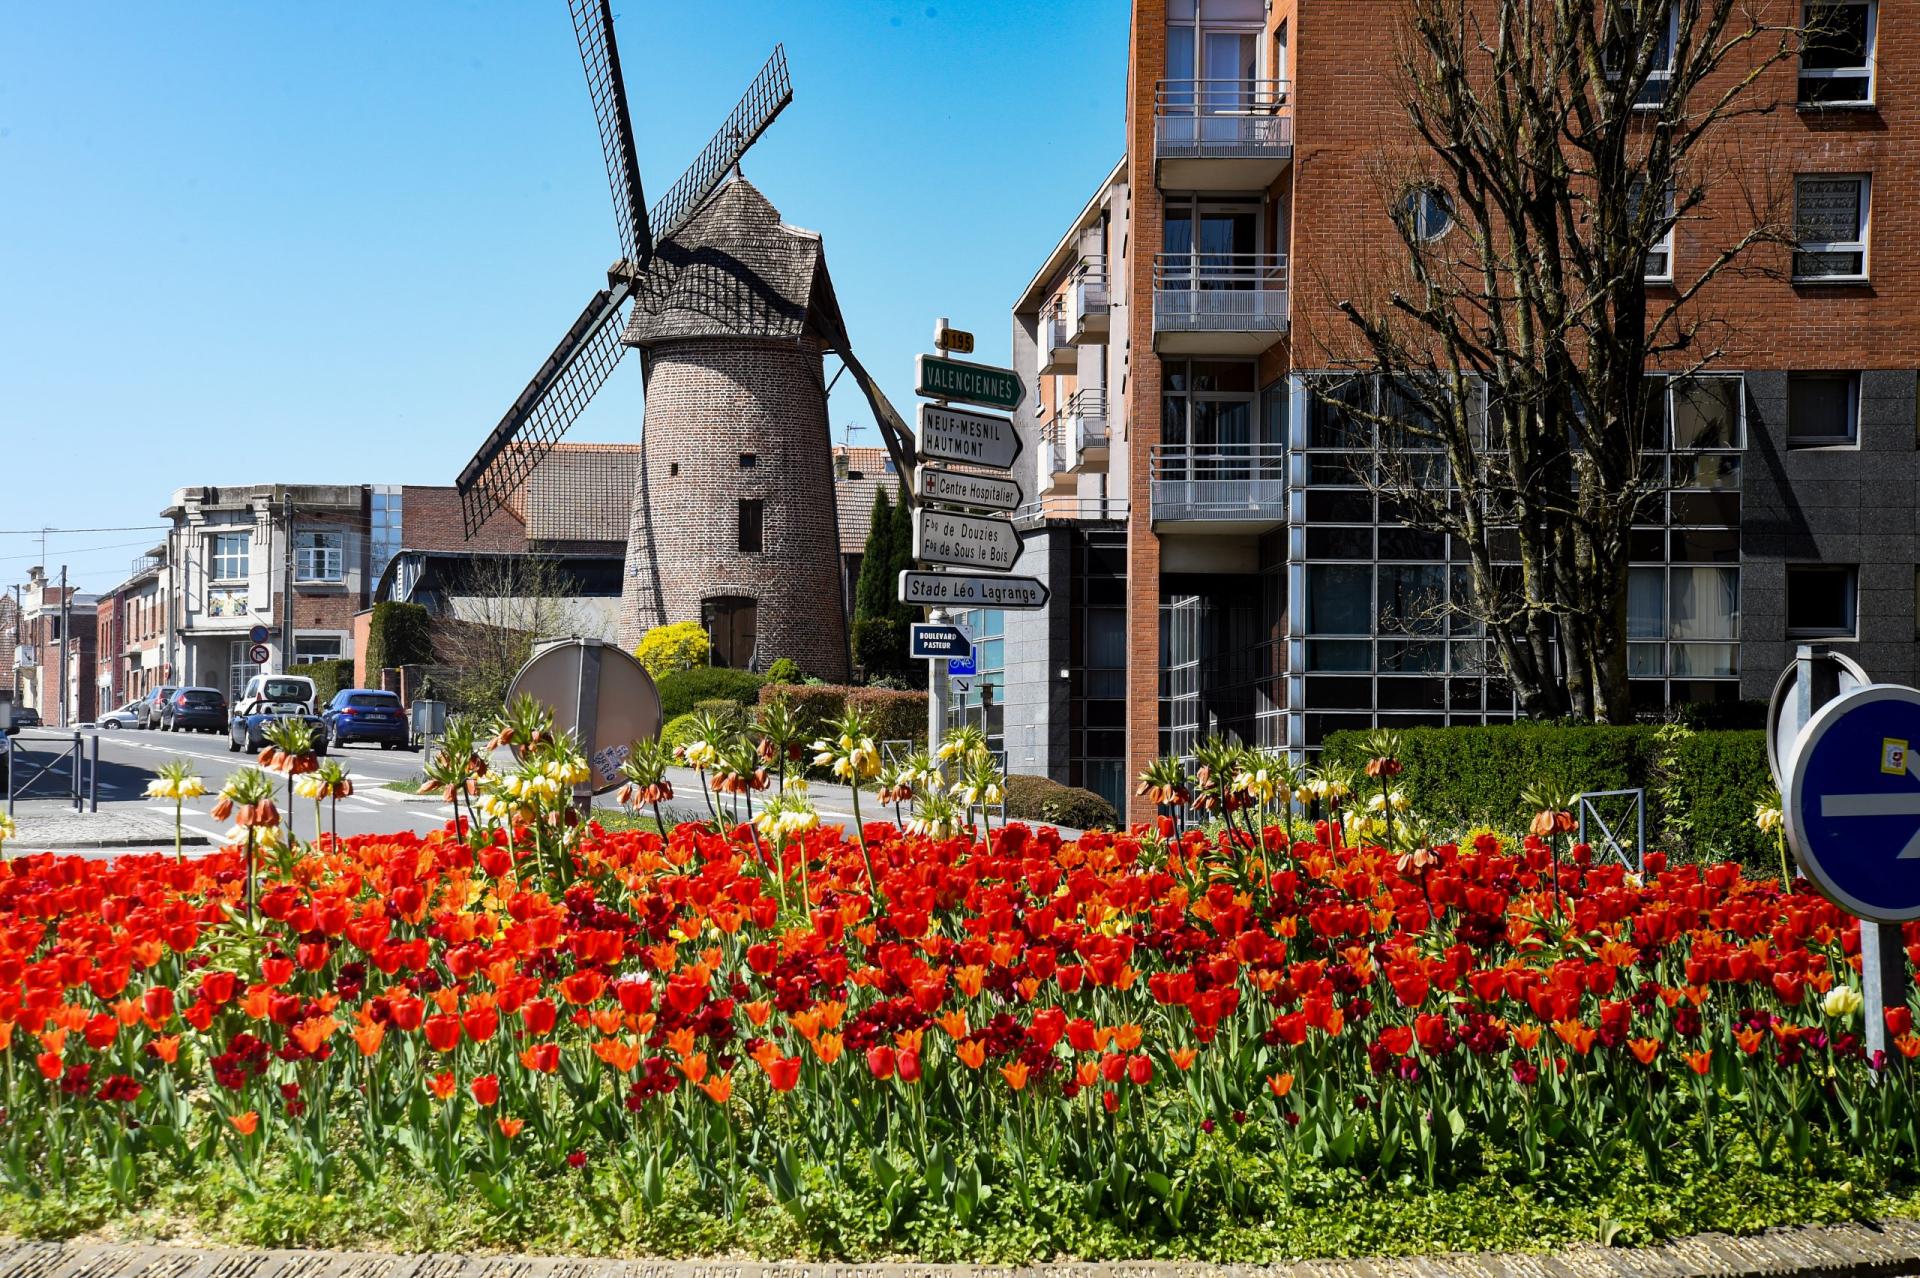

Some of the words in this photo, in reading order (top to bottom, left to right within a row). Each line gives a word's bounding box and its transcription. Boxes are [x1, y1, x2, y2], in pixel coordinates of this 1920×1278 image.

[952, 333, 971, 351] 195
[927, 366, 1012, 400] VALENCIENNES
[927, 414, 1000, 441] NEUF-MESNIL
[927, 434, 983, 457] HAUTMONT
[939, 479, 967, 496] Centre
[970, 484, 1014, 503] Hospitalier
[944, 522, 954, 537] de
[961, 523, 998, 542] Douzies
[940, 541, 950, 555] de
[954, 542, 975, 558] Sous
[979, 545, 987, 560] le
[990, 547, 1008, 562] Bois
[912, 580, 947, 596] Stade
[954, 581, 974, 598] Léo
[982, 583, 1036, 603] Lagrange
[920, 632, 957, 640] BOULEVARD
